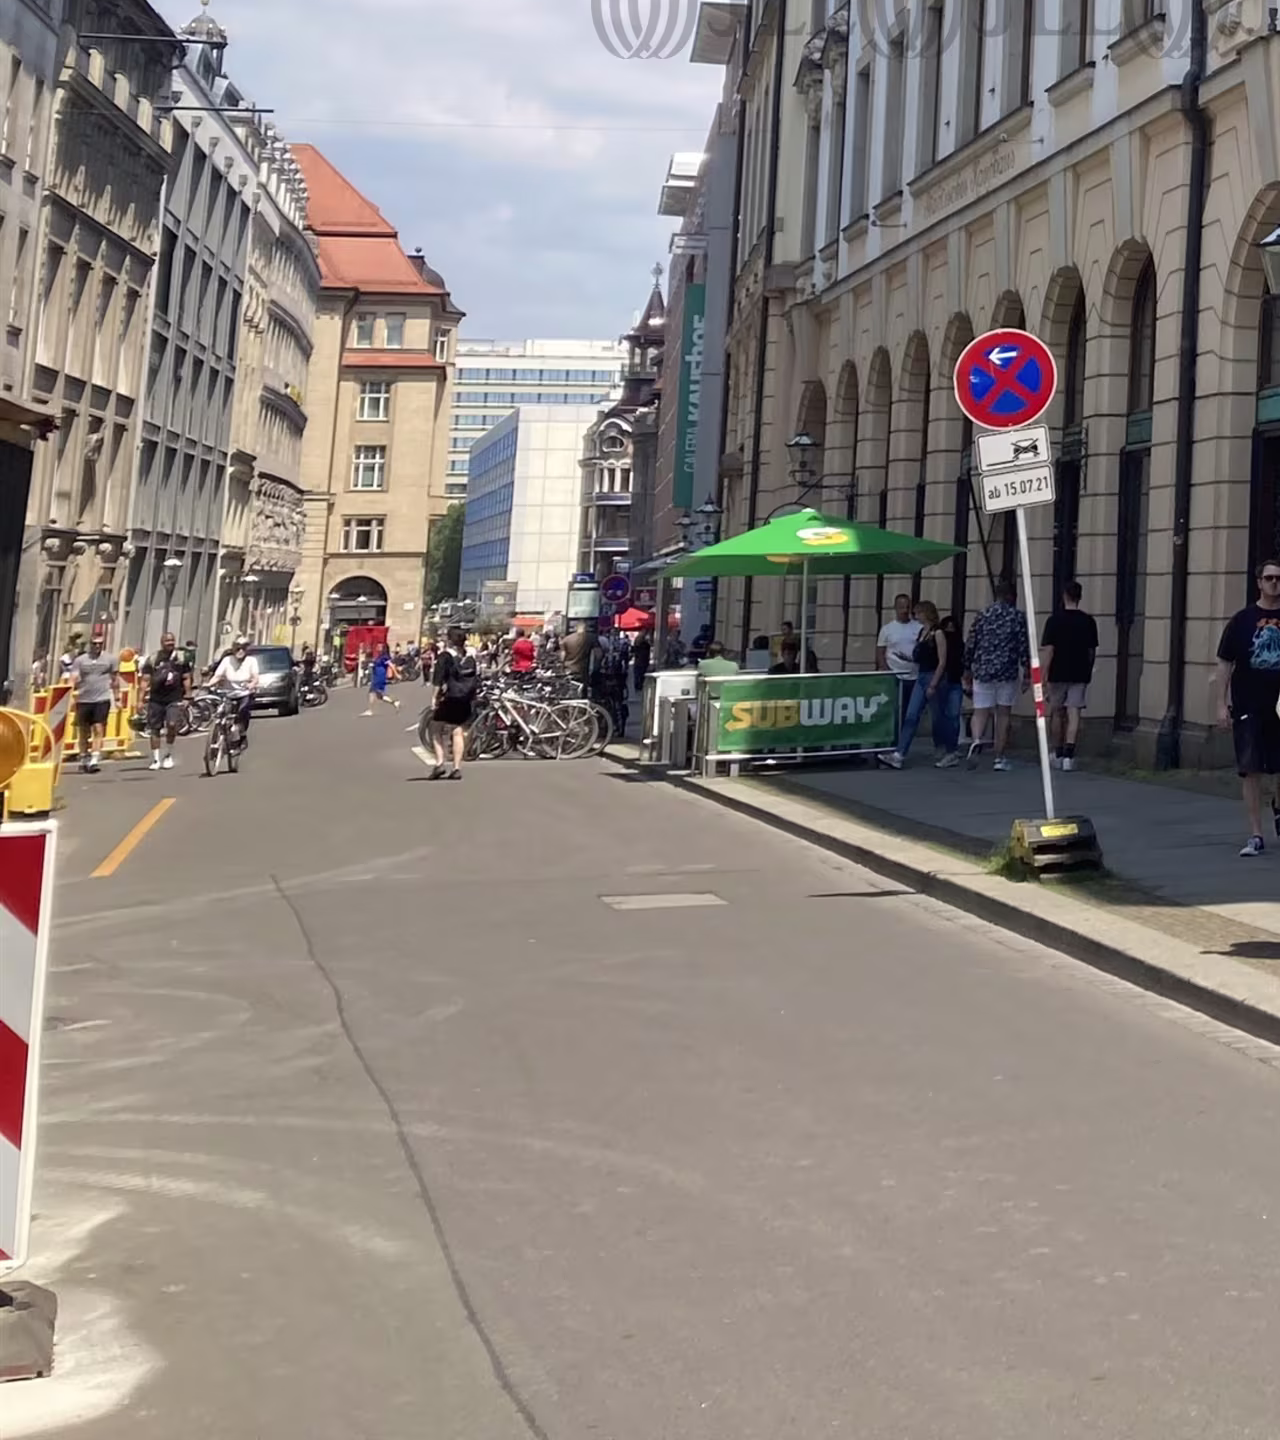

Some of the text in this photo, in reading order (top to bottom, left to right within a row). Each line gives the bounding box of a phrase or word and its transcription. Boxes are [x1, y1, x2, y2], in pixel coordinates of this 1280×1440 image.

[988, 476, 1049, 500] ab 15.07.21
[724, 692, 889, 732] SUBWAY
